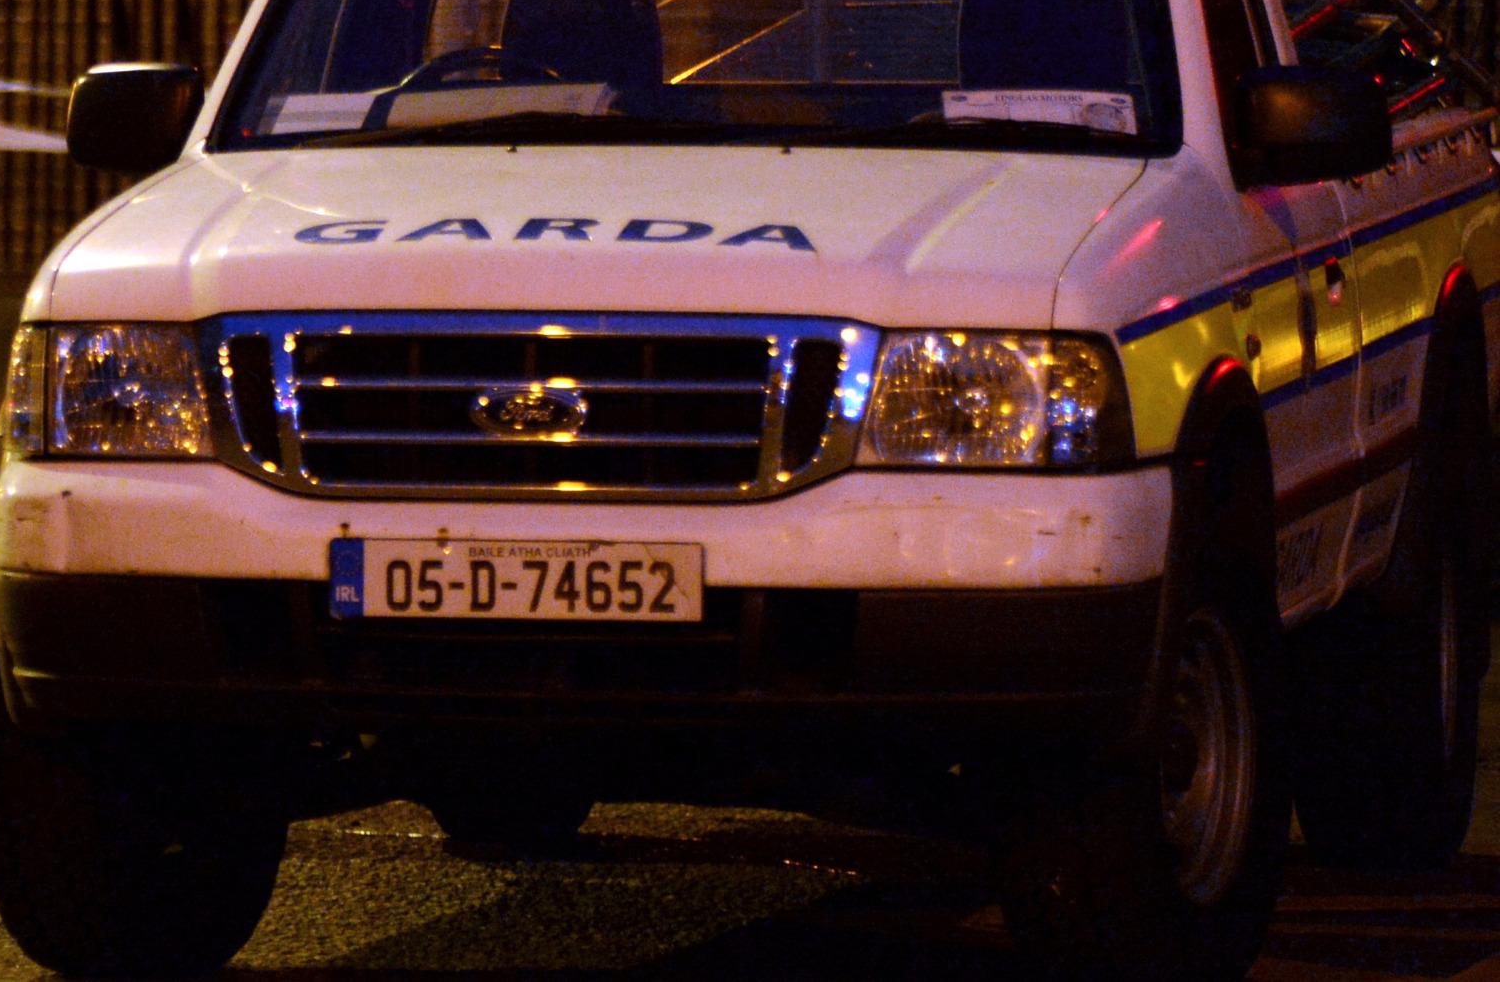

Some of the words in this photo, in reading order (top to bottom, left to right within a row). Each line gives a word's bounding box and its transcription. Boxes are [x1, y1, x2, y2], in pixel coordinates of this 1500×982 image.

[293, 217, 819, 253] GARDA
[468, 546, 505, 558] BAILE
[335, 587, 360, 603] IRL
[385, 559, 676, 614] 05-D-74652
